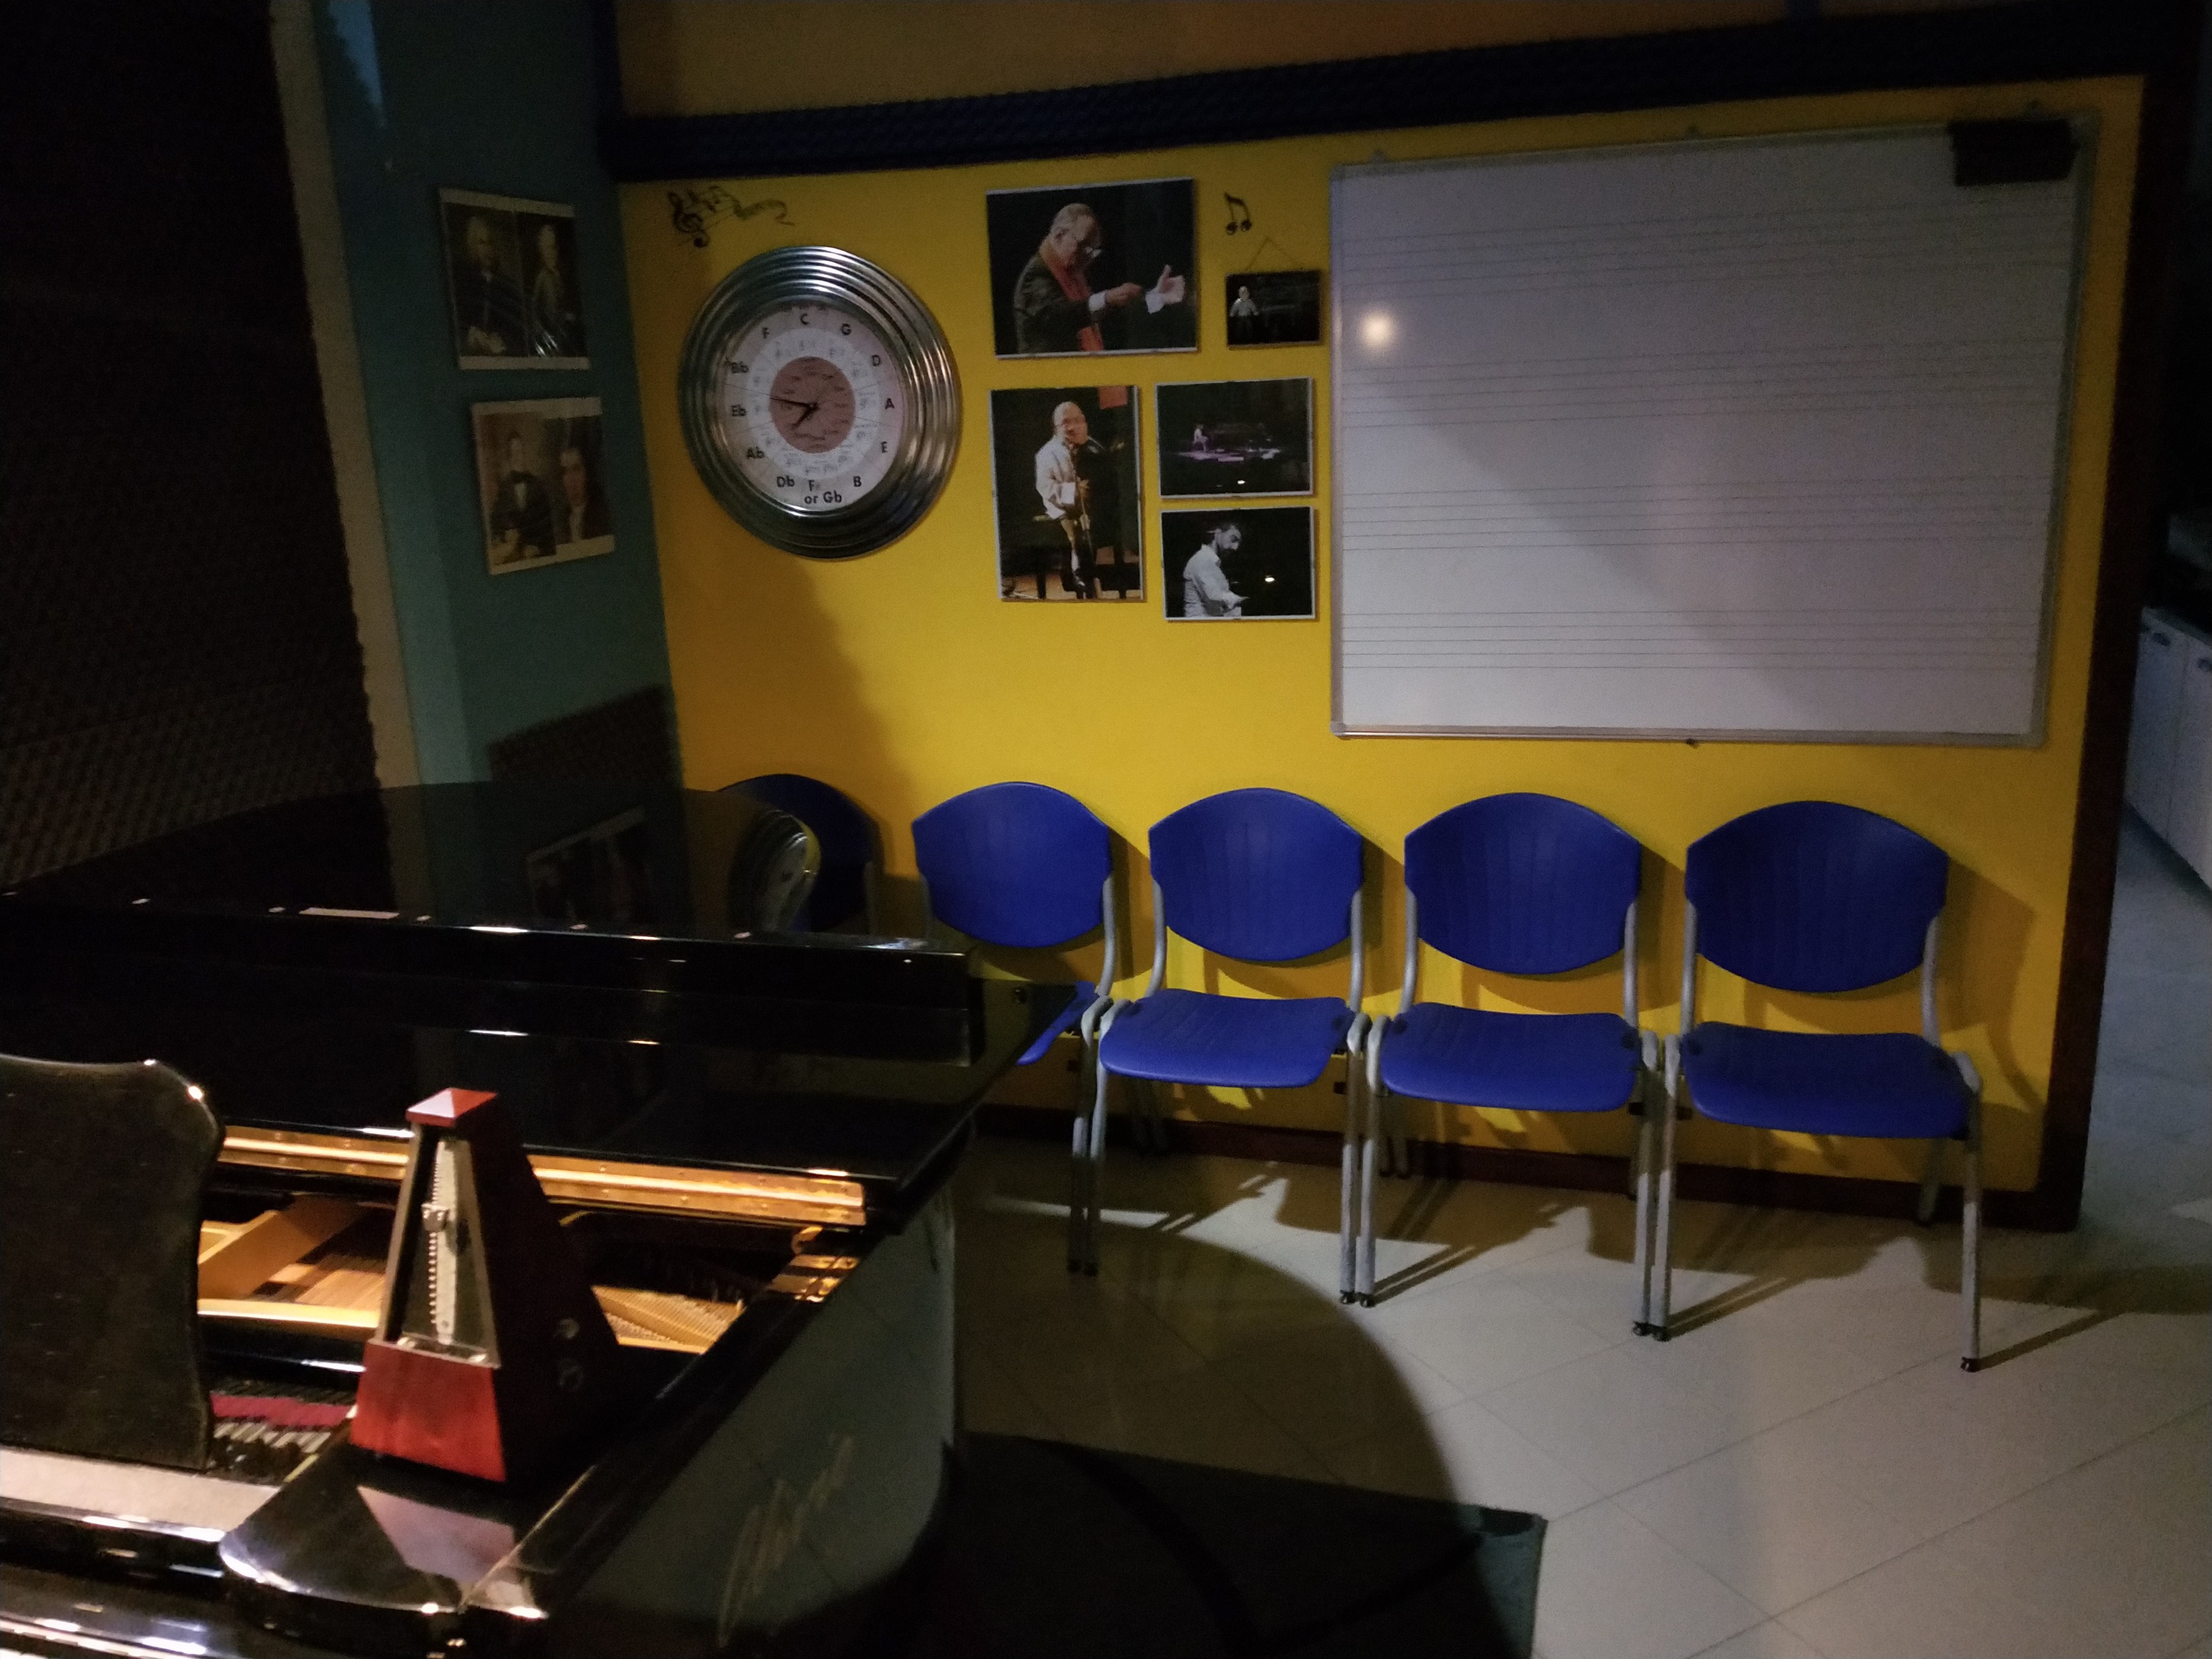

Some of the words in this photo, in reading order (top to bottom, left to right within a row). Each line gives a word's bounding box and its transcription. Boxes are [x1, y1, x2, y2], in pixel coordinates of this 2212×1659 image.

[800, 313, 809, 325] C
[762, 327, 770, 339] F
[840, 323, 851, 335] G
[872, 354, 881, 366] D
[731, 361, 749, 374] Bb
[731, 404, 747, 416] Eb
[884, 398, 895, 410] A
[746, 446, 764, 459] Ab
[881, 441, 888, 453] E
[777, 476, 795, 488] Db
[853, 476, 862, 487] B
[804, 494, 818, 505] or
[823, 490, 842, 503] Gb
